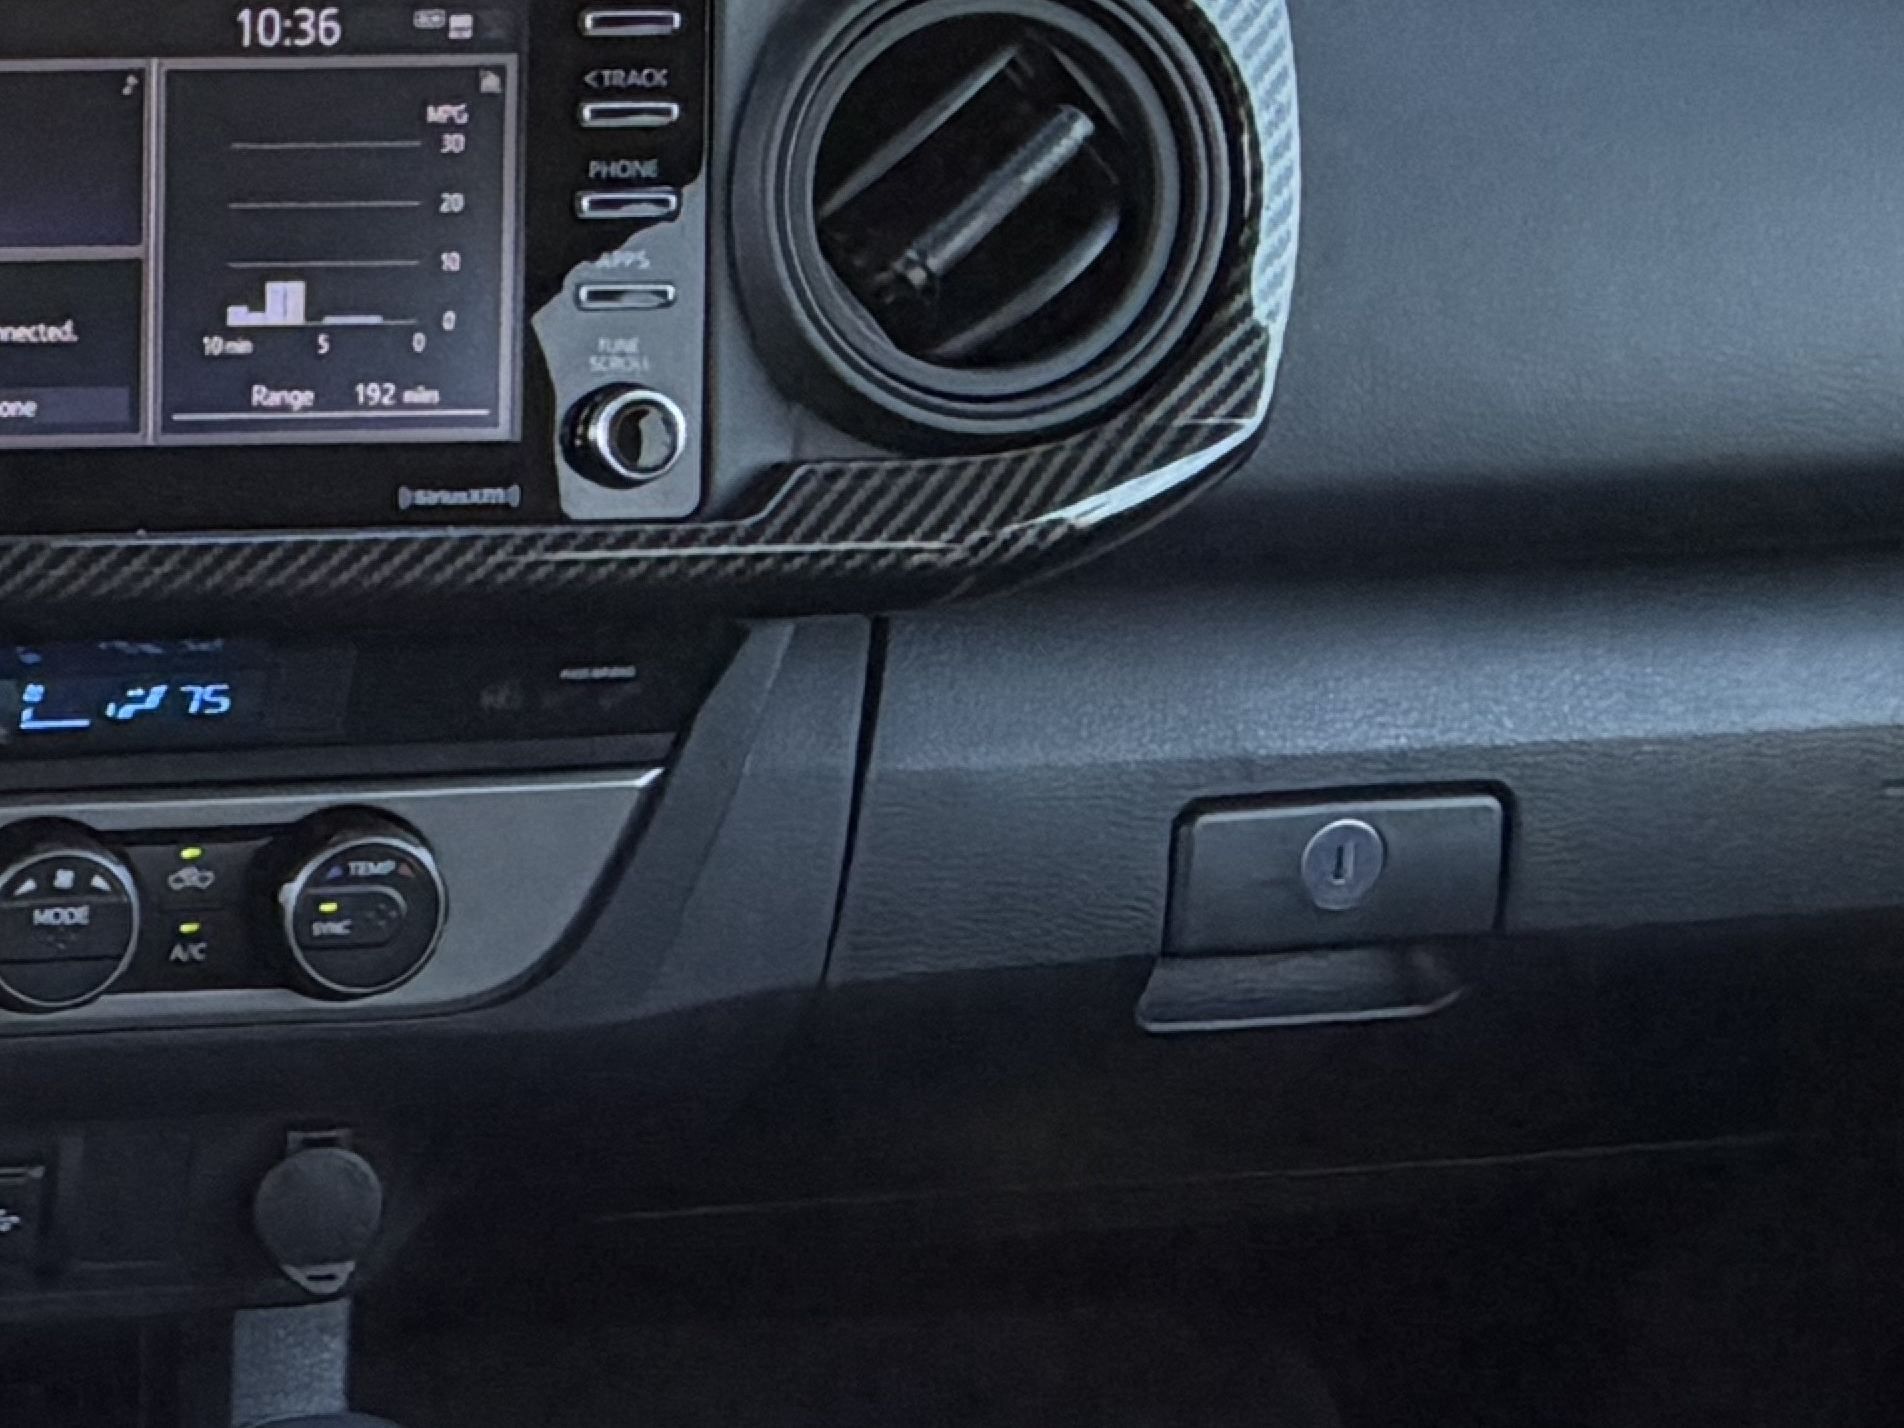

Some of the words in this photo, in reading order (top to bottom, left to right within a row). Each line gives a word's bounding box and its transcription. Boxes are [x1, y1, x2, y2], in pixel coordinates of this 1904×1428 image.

[236, 6, 341, 48] 10:36
[440, 132, 466, 154] 30
[588, 158, 658, 179] PHONE
[439, 192, 465, 214] 20
[440, 251, 462, 272] 10
[441, 310, 456, 332] 0
[202, 335, 223, 356] 10
[317, 333, 330, 356] 5
[412, 332, 426, 354] 0
[251, 384, 316, 411] Range
[354, 382, 396, 407] 192
[180, 683, 232, 715] 75
[348, 860, 396, 876] TEMP
[32, 904, 90, 925] MODE
[169, 943, 208, 962] A/C
